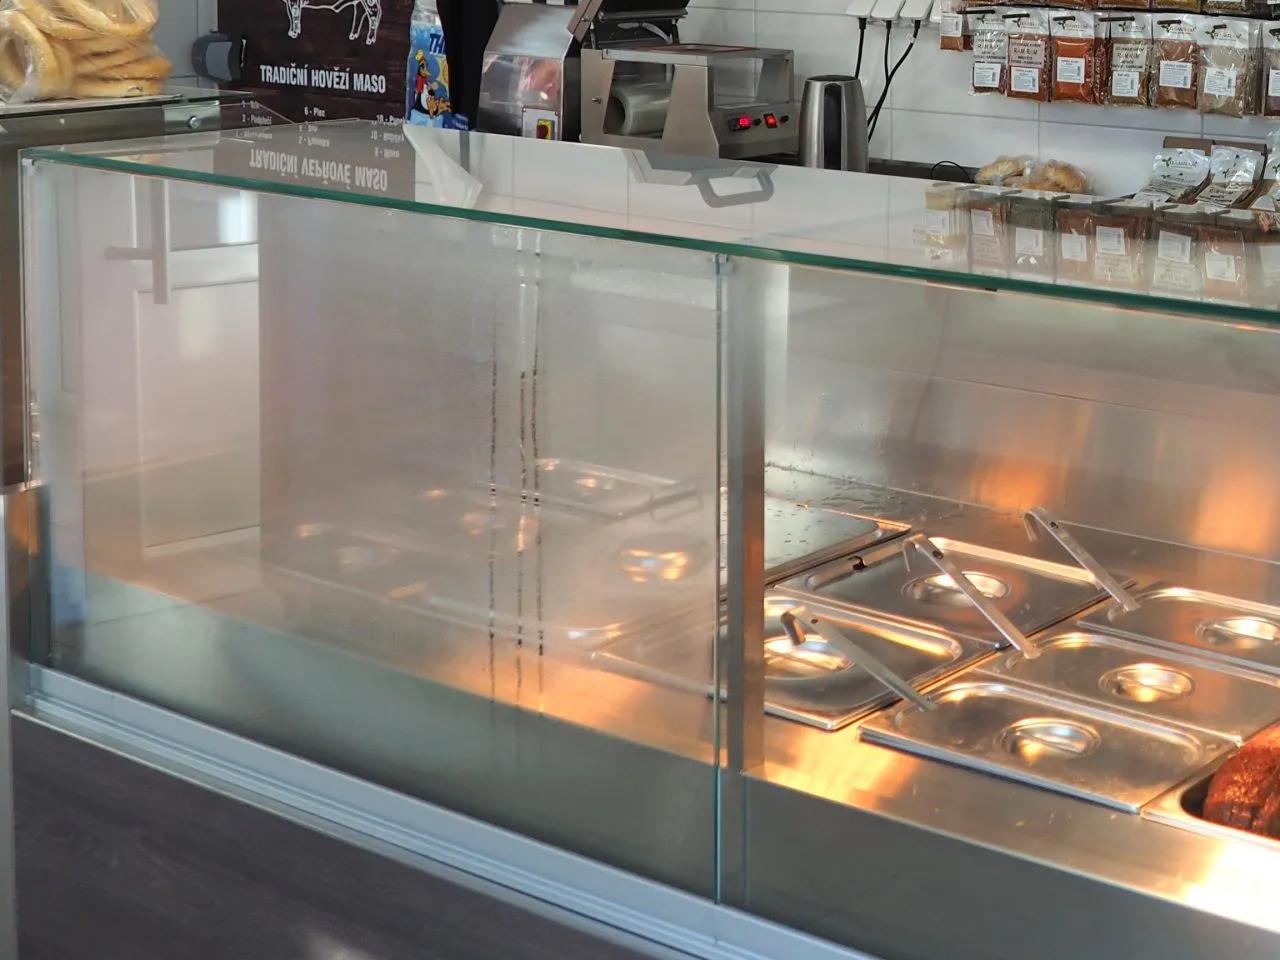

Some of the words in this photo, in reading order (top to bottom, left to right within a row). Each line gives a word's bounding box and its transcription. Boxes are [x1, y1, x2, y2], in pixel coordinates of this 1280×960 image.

[260, 63, 308, 85] TRADIČNÍ
[311, 66, 350, 91] HOVĚZÍ
[353, 75, 386, 94] MASO
